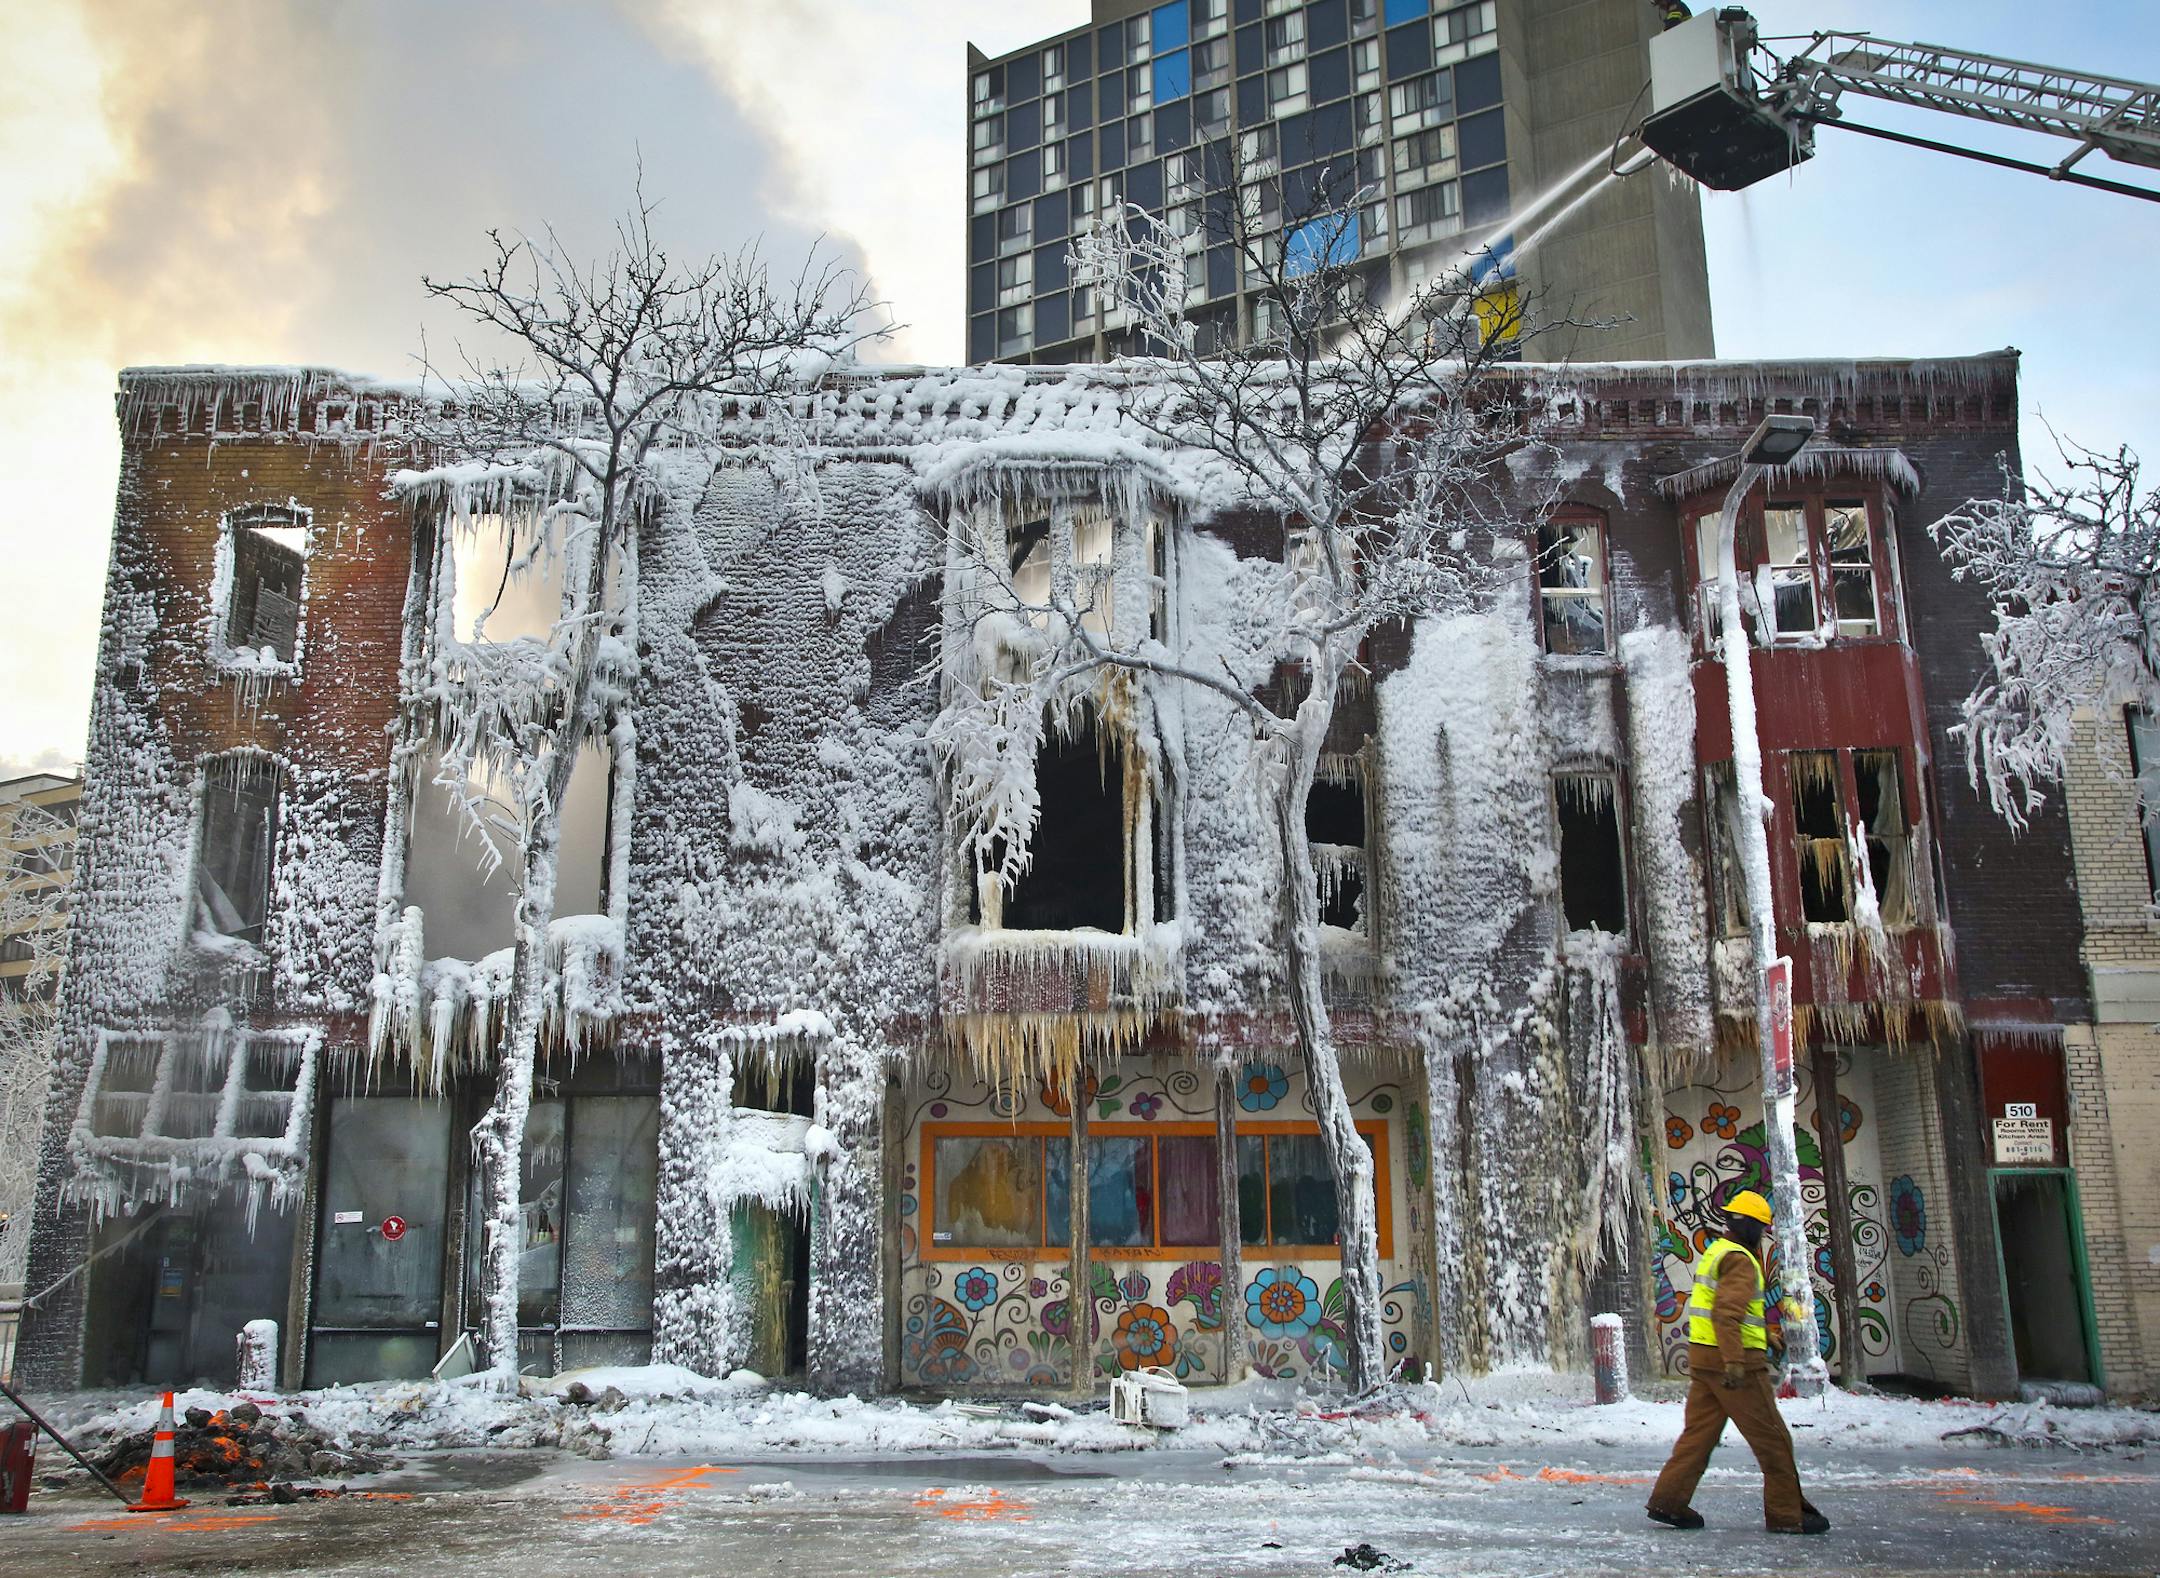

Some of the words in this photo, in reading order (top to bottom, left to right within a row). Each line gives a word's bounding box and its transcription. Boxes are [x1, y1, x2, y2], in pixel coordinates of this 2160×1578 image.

[2010, 1105, 2033, 1117] 510
[1995, 1120, 2016, 1128] For
[2020, 1120, 2049, 1128] Rent
